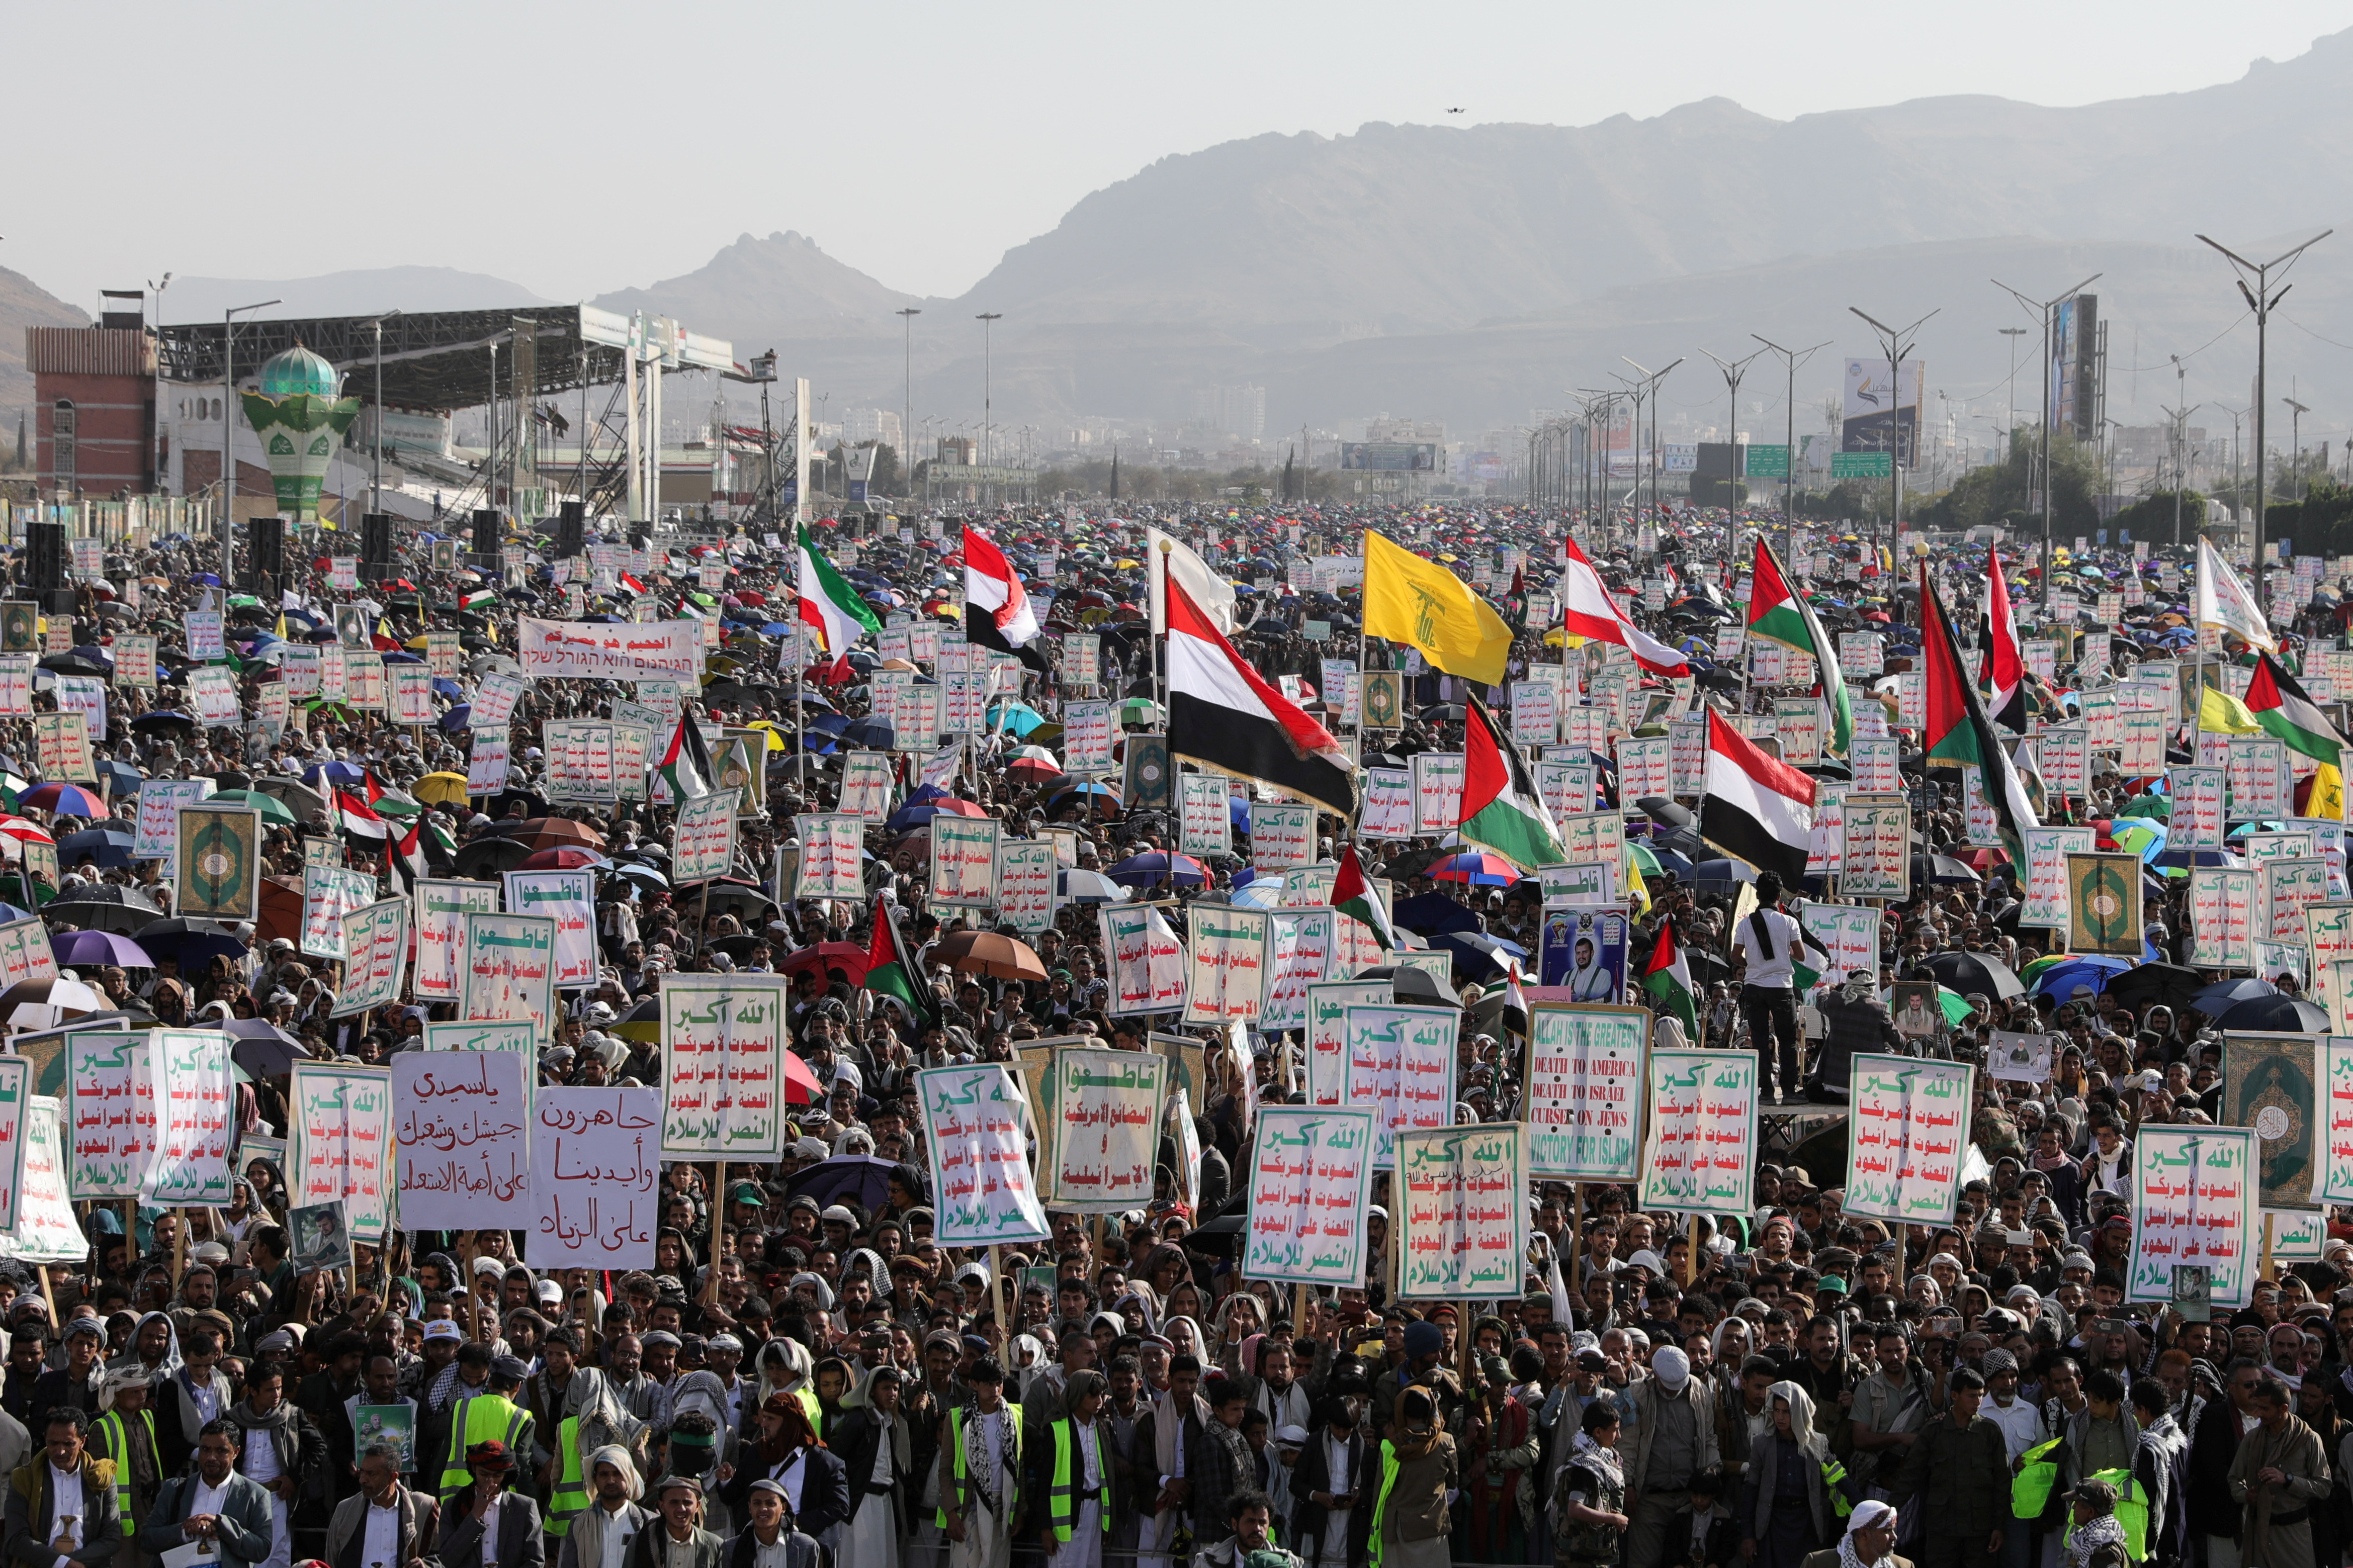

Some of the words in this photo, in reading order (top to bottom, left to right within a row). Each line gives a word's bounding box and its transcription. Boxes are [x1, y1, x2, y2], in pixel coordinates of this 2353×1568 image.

[545, 631, 596, 647] مصيركم
[604, 638, 620, 649] هو
[627, 636, 671, 653] الجحيم
[523, 647, 553, 667] שלך
[556, 648, 599, 665] הגורל
[603, 654, 630, 666] הוא
[634, 658, 692, 671] הגיהנום
[2202, 774, 2219, 787] الله
[2198, 793, 2219, 803] الموت
[1883, 811, 1904, 825] الله
[2197, 807, 2218, 817] الموت
[939, 824, 992, 844] قاطعوا
[2172, 820, 2187, 831] اليهود
[2189, 820, 2198, 831] على
[1879, 832, 1903, 843] الموت
[2195, 833, 2217, 848] النصر
[966, 850, 991, 866] البضائع
[1878, 848, 1902, 858] الموت
[958, 868, 964, 879] و
[1847, 862, 1867, 874] اليهود
[1869, 862, 1880, 873] على
[1876, 875, 1901, 891] النصر
[672, 993, 733, 1032] أكبر
[736, 997, 774, 1024] الله
[674, 1031, 724, 1056] لأمريكا
[729, 1035, 773, 1056] الموت
[1536, 1020, 1562, 1045] ALLAH
[1565, 1021, 1573, 1046] IS
[1576, 1022, 1593, 1046] THE
[1594, 1023, 1638, 1049] GREATEST
[75, 1038, 140, 1076] أكبر
[1534, 1057, 1568, 1074] DEATH
[1572, 1059, 1586, 1074] TO
[1590, 1059, 1636, 1077] AMERICA
[673, 1062, 724, 1085] لإسرائيل
[728, 1063, 773, 1084] الموت
[1066, 1062, 1155, 1093] قاطعوا
[1657, 1059, 1712, 1095] أكبر
[1713, 1064, 1749, 1089] الله
[1859, 1065, 1923, 1097] أكبر
[76, 1075, 131, 1100] لأمريكا
[1532, 1083, 1567, 1099] DEATH
[1572, 1084, 1585, 1099] TO
[1589, 1085, 1625, 1101] ISRAEL
[1924, 1072, 1962, 1098] الله
[671, 1090, 707, 1112] اليهود
[712, 1091, 732, 1112] على
[739, 1090, 772, 1109] اللعنة
[1658, 1093, 1702, 1118] لأمريكا
[1706, 1100, 1747, 1119] الموت
[1859, 1098, 1911, 1122] لأمريكا
[76, 1107, 131, 1130] لإسرائيل
[458, 1110, 522, 1147] جيشك
[1109, 1105, 1152, 1130] البضائع
[1577, 1110, 1593, 1126] ON
[1597, 1110, 1627, 1127] JEWS
[1915, 1110, 1959, 1128] الموت
[396, 1110, 456, 1152] وشعبك
[667, 1117, 721, 1147] للإسلام
[723, 1115, 771, 1145] النصر
[1661, 1124, 1701, 1145] لإسرائيل
[1706, 1127, 1746, 1145] الموت
[1858, 1126, 1909, 1154] لإسرائيل
[76, 1136, 115, 1157] اليهود
[120, 1136, 141, 1157] على
[1101, 1134, 1107, 1153] و
[1408, 1132, 1470, 1170] أكبر
[1472, 1136, 1511, 1161] الله
[1530, 1134, 1574, 1163] VICTORY
[1576, 1136, 1596, 1164] FOR
[1598, 1137, 1629, 1165] ISLAM
[1914, 1138, 1957, 1156] الموت
[2206, 1141, 2241, 1168] الله
[553, 1135, 653, 1192] وأيدينا
[1654, 1151, 1686, 1172] اليهود
[1690, 1152, 1708, 1171] على
[1713, 1151, 1744, 1170] اللعنة
[1856, 1156, 1892, 1176] اليهود
[2145, 1136, 2204, 1174] أكبر
[75, 1162, 129, 1193] للإسلام
[1061, 1162, 1149, 1190] الإسرائيلية
[1896, 1160, 1914, 1179] على
[1921, 1161, 1954, 1183] اللعنة
[1467, 1172, 1512, 1194] الموت
[1650, 1175, 1697, 1204] للإسلام
[1700, 1175, 1742, 1202] النصر
[2145, 1173, 2194, 1199] لأمريكا
[2199, 1181, 2241, 1201] الموت
[1851, 1179, 1901, 1213] للإسلام
[1903, 1188, 1951, 1214] النصر
[540, 1193, 597, 1249] الزناد
[1410, 1202, 1463, 1226] لإسرائيل
[1467, 1202, 1511, 1225] الموت
[2144, 1206, 2193, 1231] لإسرائيل
[2197, 1210, 2240, 1231] الموت
[600, 1200, 650, 1251] على
[2275, 1219, 2317, 1250] النصر
[1410, 1232, 1446, 1255] اليهود
[1451, 1231, 1471, 1254] على
[1478, 1231, 1512, 1250] اللعنة
[2141, 1236, 2177, 1259] اليهود
[2181, 1237, 2199, 1259] على
[2206, 1237, 2239, 1258] اللعنة
[1409, 1259, 1461, 1292] للإسلام
[1465, 1256, 1512, 1288] النصر
